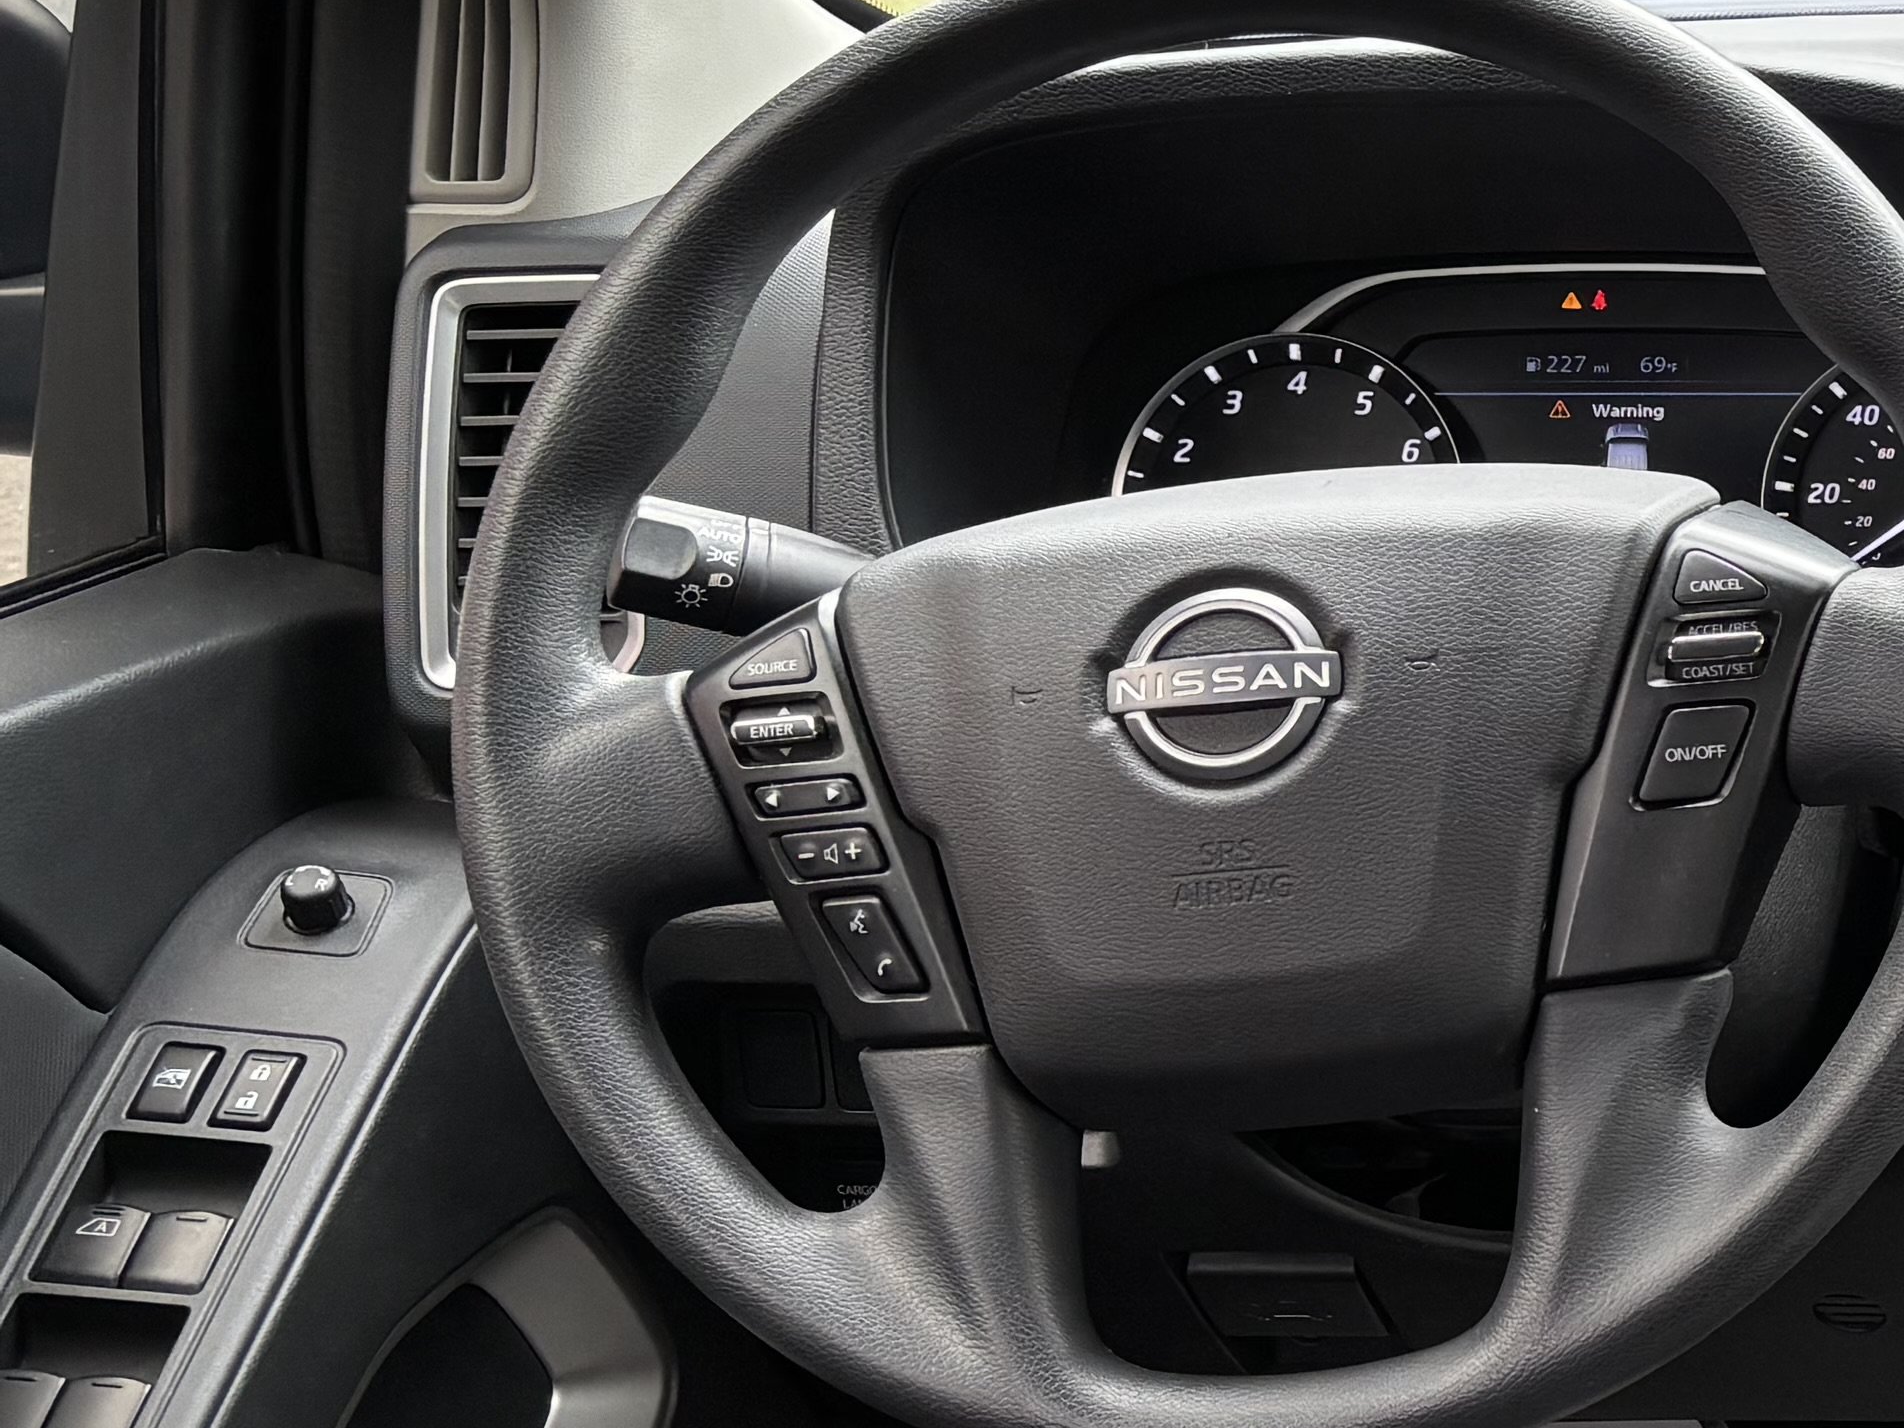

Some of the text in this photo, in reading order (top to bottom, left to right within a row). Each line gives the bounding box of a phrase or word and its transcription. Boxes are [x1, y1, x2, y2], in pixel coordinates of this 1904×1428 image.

[1546, 355, 1610, 373] 227 mi
[1287, 371, 1308, 395] 4
[1222, 390, 1243, 415] 3
[1354, 391, 1374, 415] 5
[1592, 404, 1665, 421] Warning
[1846, 405, 1881, 426] 40
[1173, 438, 1194, 463] 2
[1401, 439, 1421, 463] 6
[1877, 447, 1896, 460] 60
[1807, 483, 1841, 504] 20
[1858, 479, 1876, 491] 40
[1855, 515, 1873, 528] 20
[1690, 578, 1744, 592] CANCEL
[747, 659, 798, 677] SOURCE
[1682, 661, 1755, 679] COAST/SET
[1114, 661, 1331, 705] NISSAN
[749, 723, 794, 739] ENTER
[1665, 744, 1727, 762] ON/OFF
[1202, 841, 1254, 867] SRS
[314, 878, 328, 892] R
[1174, 875, 1294, 909] AIRBAG
